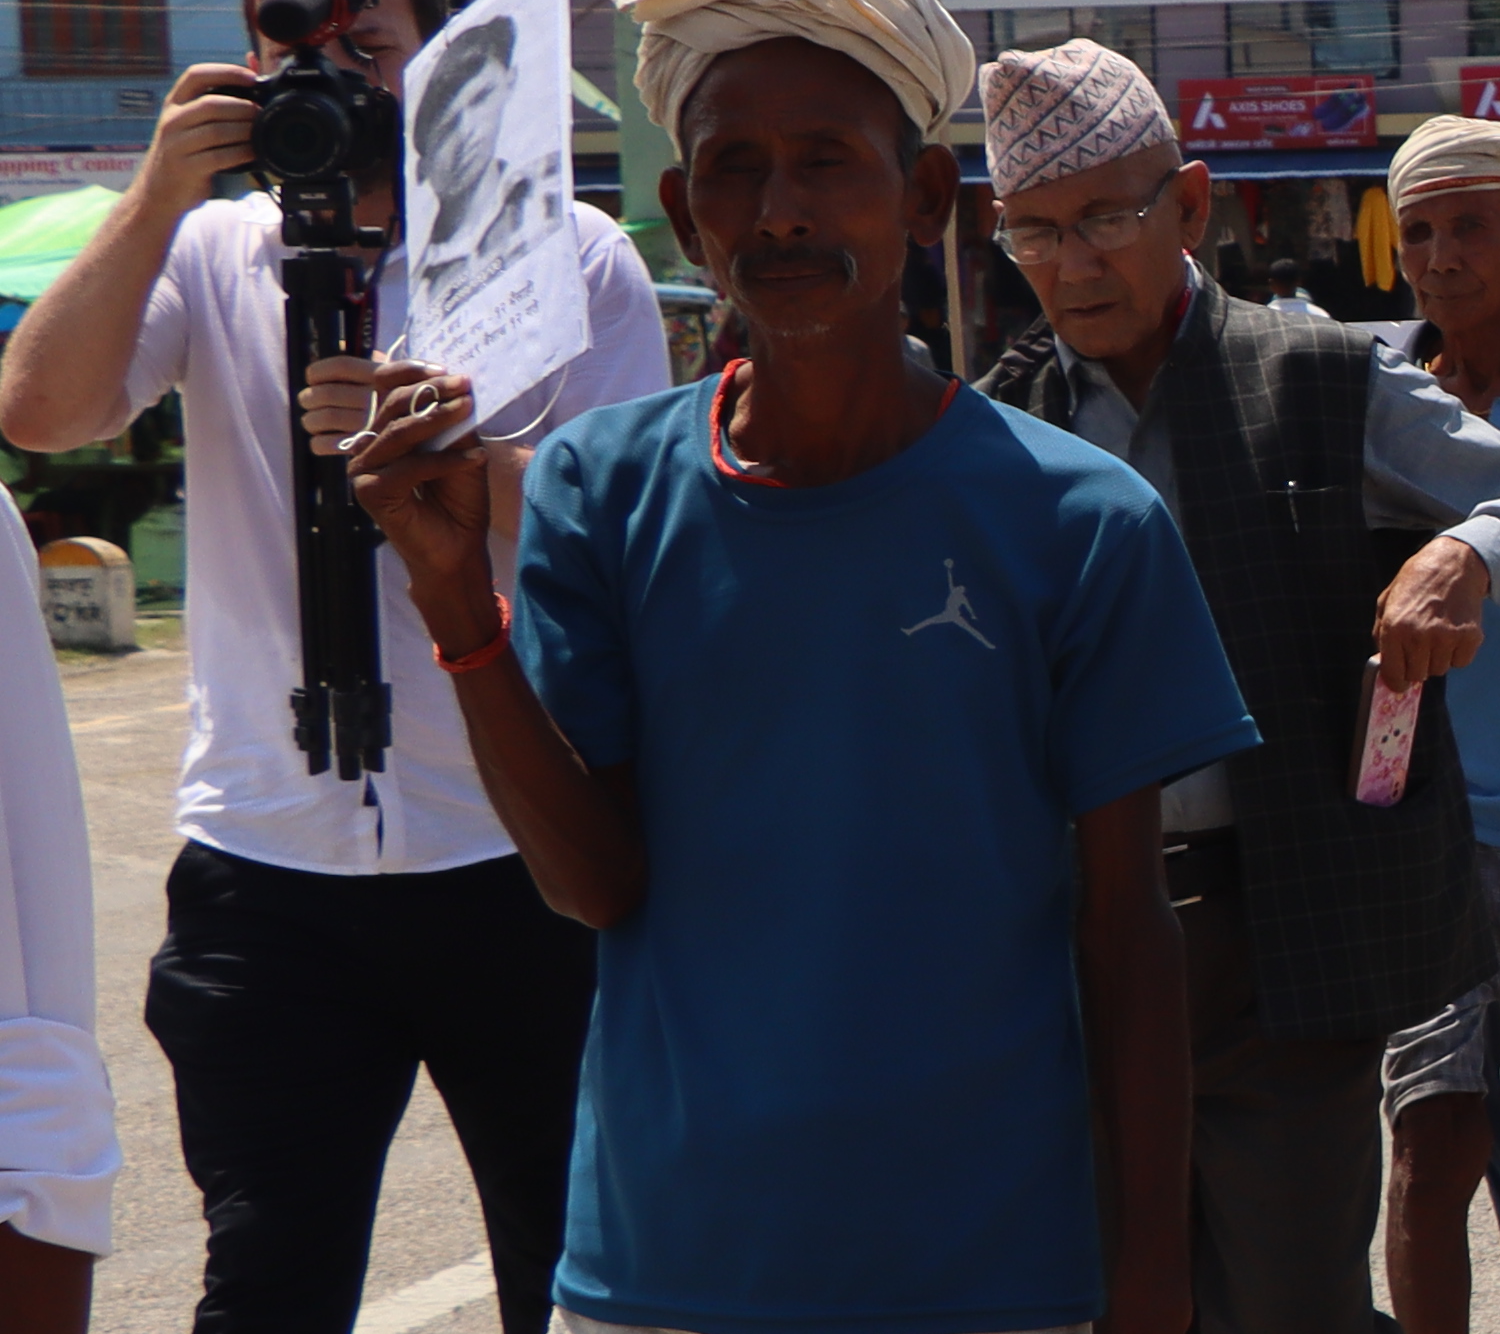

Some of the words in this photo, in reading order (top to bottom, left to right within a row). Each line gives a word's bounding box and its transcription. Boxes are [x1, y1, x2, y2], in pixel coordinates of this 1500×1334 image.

[1229, 101, 1258, 113] AXIS
[1261, 100, 1306, 112] SHOES
[0, 157, 59, 177] pping
[64, 153, 138, 172] Center
